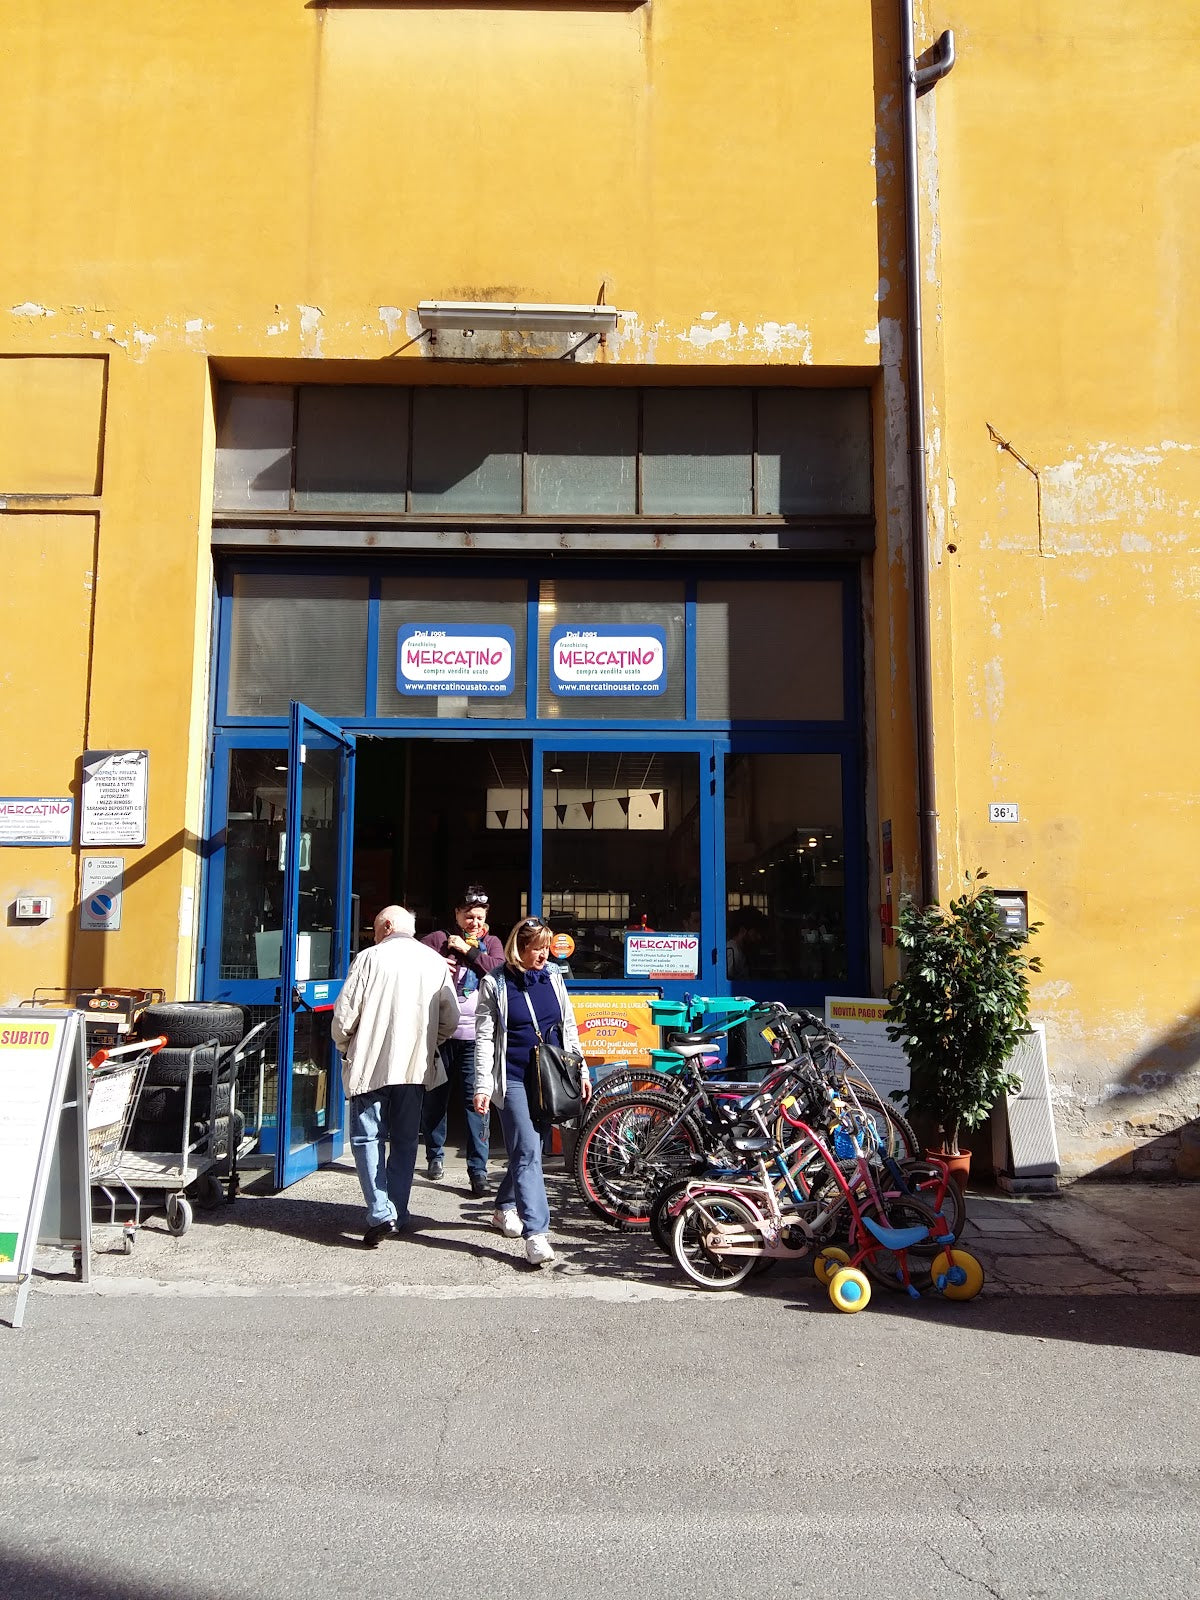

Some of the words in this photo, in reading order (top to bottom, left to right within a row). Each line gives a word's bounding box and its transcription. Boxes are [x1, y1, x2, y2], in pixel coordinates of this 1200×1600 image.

[407, 648, 502, 668] MERCATINO
[560, 648, 655, 668] MERCATINO
[405, 682, 507, 691] www.mercatinousato.com
[558, 683, 659, 691] www.mercatinousato.com
[994, 808, 1006, 817] 36
[630, 939, 697, 950] MERCATINO
[832, 1006, 856, 1016] NOVITÀ
[858, 1008, 876, 1018] PAGO
[585, 1020, 601, 1029] CON
[601, 1018, 628, 1028] L'USATO
[1, 1030, 49, 1045] SUBITO
